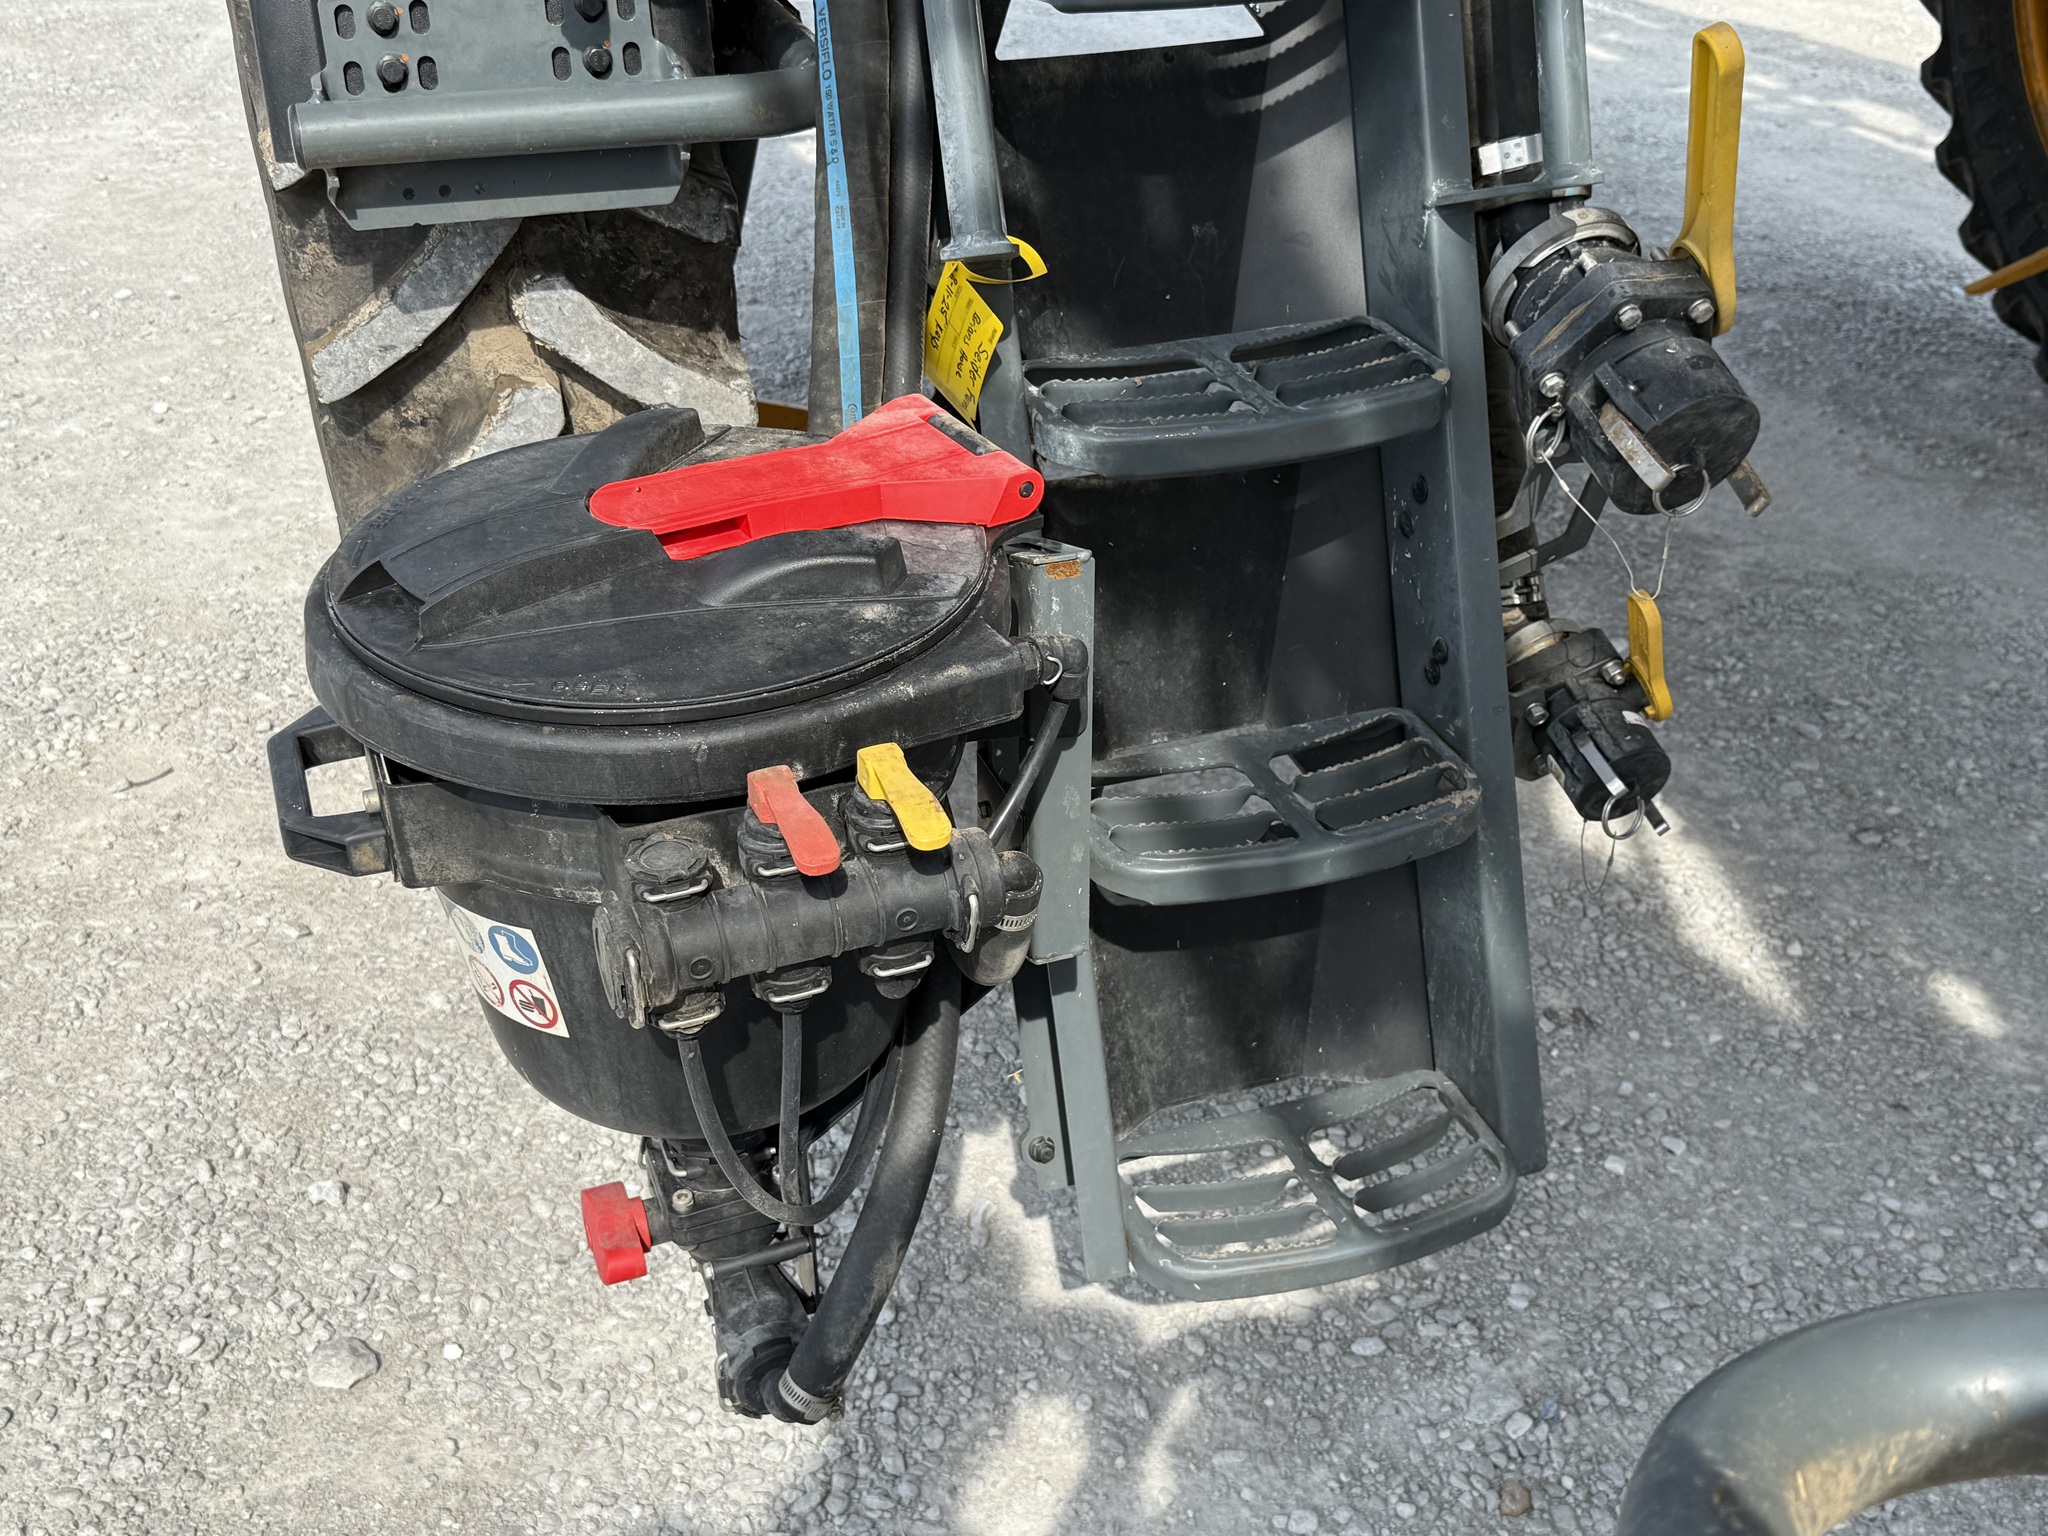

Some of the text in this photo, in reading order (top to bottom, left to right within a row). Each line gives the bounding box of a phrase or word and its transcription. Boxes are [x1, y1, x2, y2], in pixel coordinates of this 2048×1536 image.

[818, 7, 832, 81] VERSIFLO
[825, 84, 833, 101] 150
[826, 101, 837, 137] WATER
[969, 341, 989, 388] Seider
[551, 680, 629, 696] OPEN
